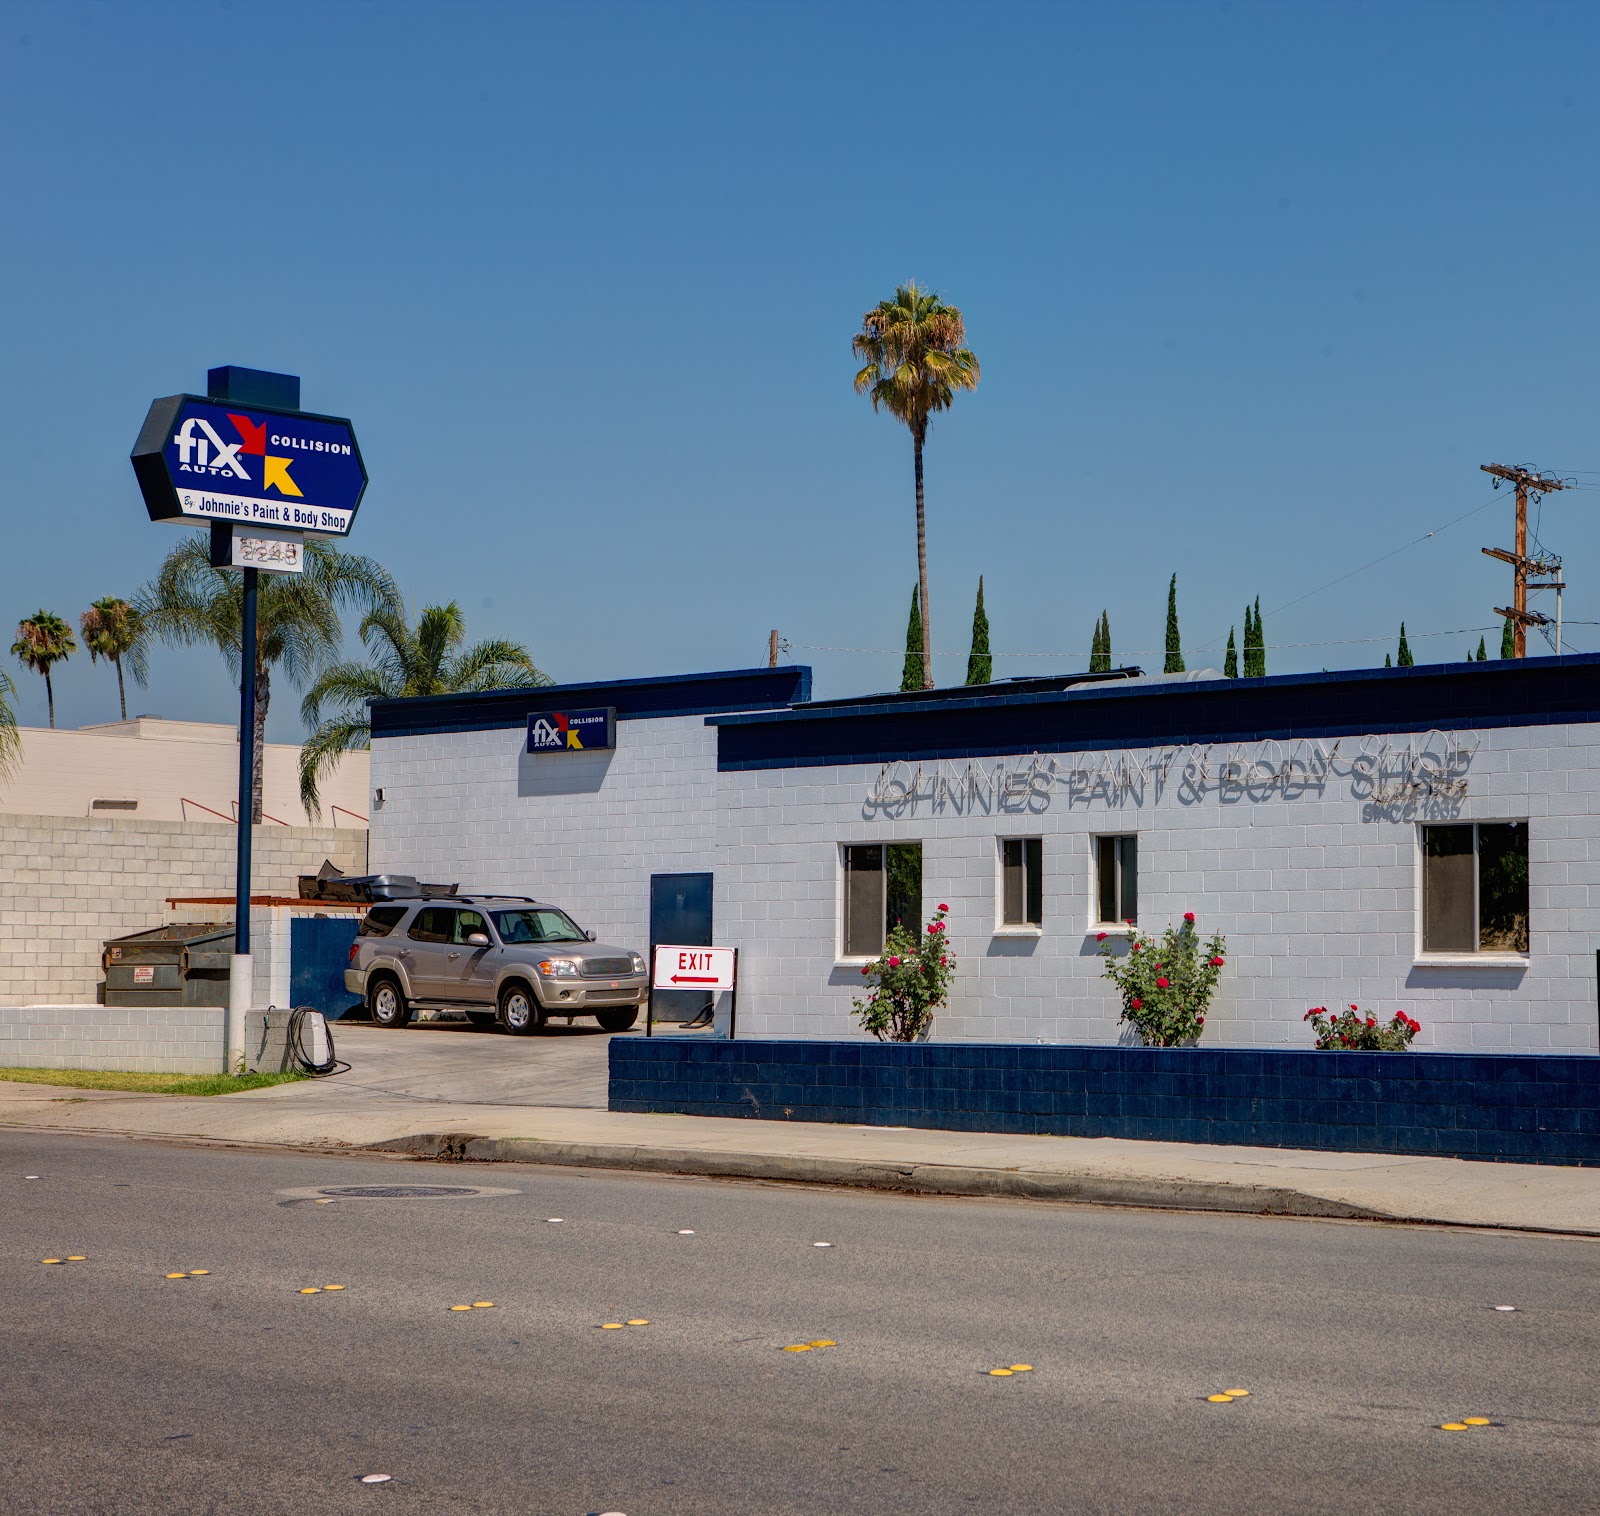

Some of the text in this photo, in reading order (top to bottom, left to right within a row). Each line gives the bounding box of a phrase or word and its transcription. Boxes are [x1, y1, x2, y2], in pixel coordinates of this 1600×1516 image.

[174, 418, 252, 480] fix
[270, 434, 351, 456] COLLISION
[179, 463, 234, 478] AUTO
[199, 496, 249, 517] Johnnie's
[253, 503, 279, 520] Paint
[283, 507, 290, 522] &
[294, 508, 318, 528] Body
[321, 512, 346, 532] Shop
[569, 716, 604, 725] COLLISION
[1069, 748, 1170, 811] PAINT
[1177, 745, 1214, 806] &
[1219, 741, 1338, 804] BODY
[1351, 732, 1478, 800] SHOP
[678, 952, 713, 971] EXIT
